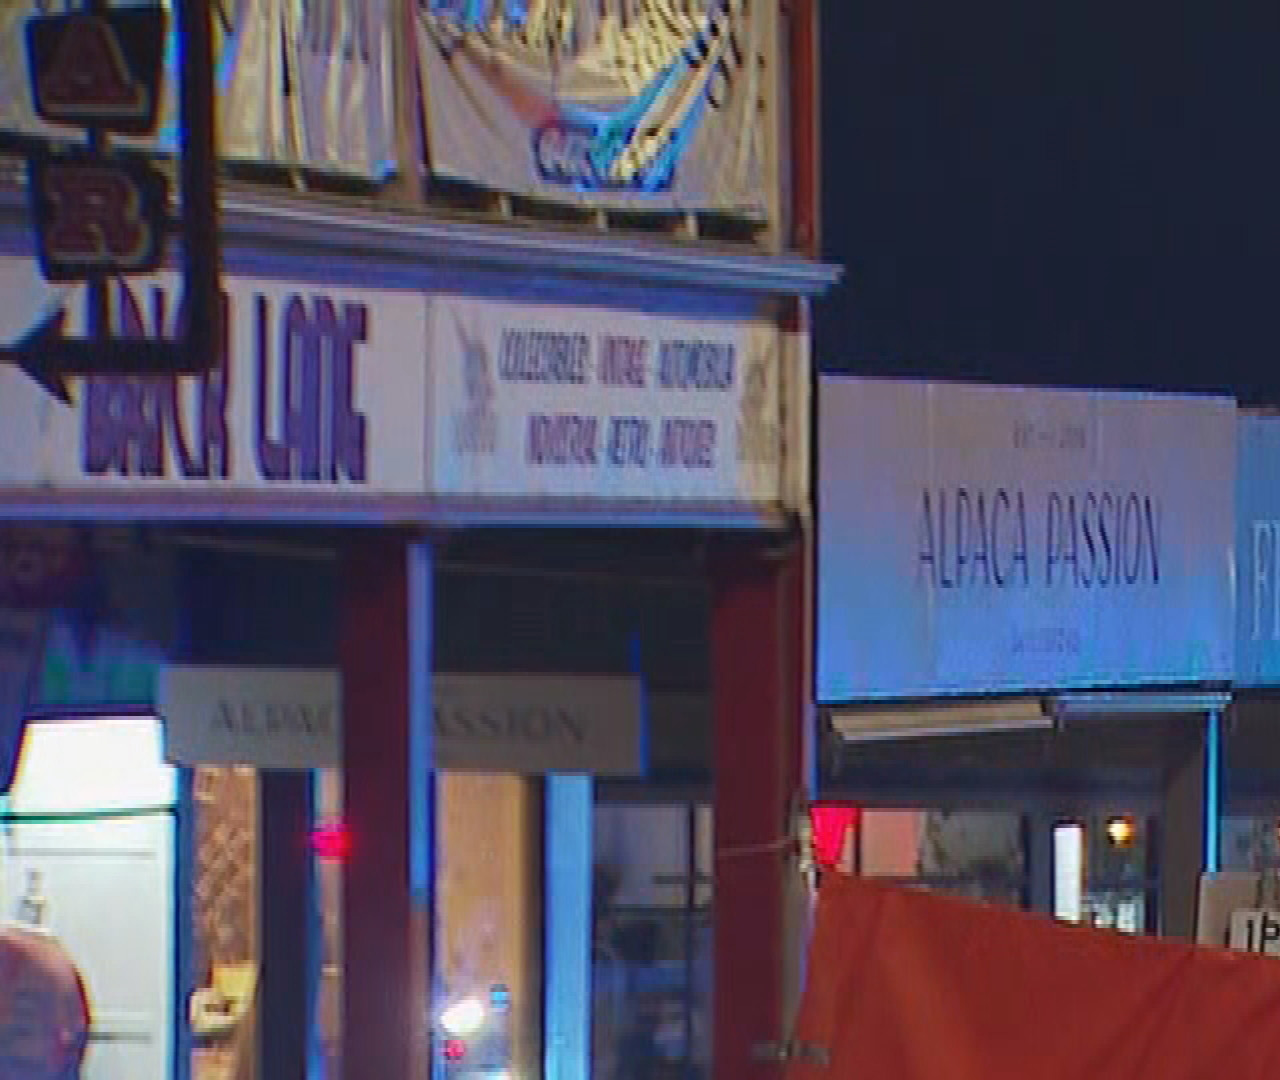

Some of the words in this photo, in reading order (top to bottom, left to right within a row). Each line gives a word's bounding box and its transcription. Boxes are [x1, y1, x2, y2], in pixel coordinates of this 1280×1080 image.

[255, 292, 367, 482] LANE
[919, 488, 1028, 588] ALPACA
[1046, 491, 1160, 587] PASSION
[211, 702, 338, 737] ALPAC
